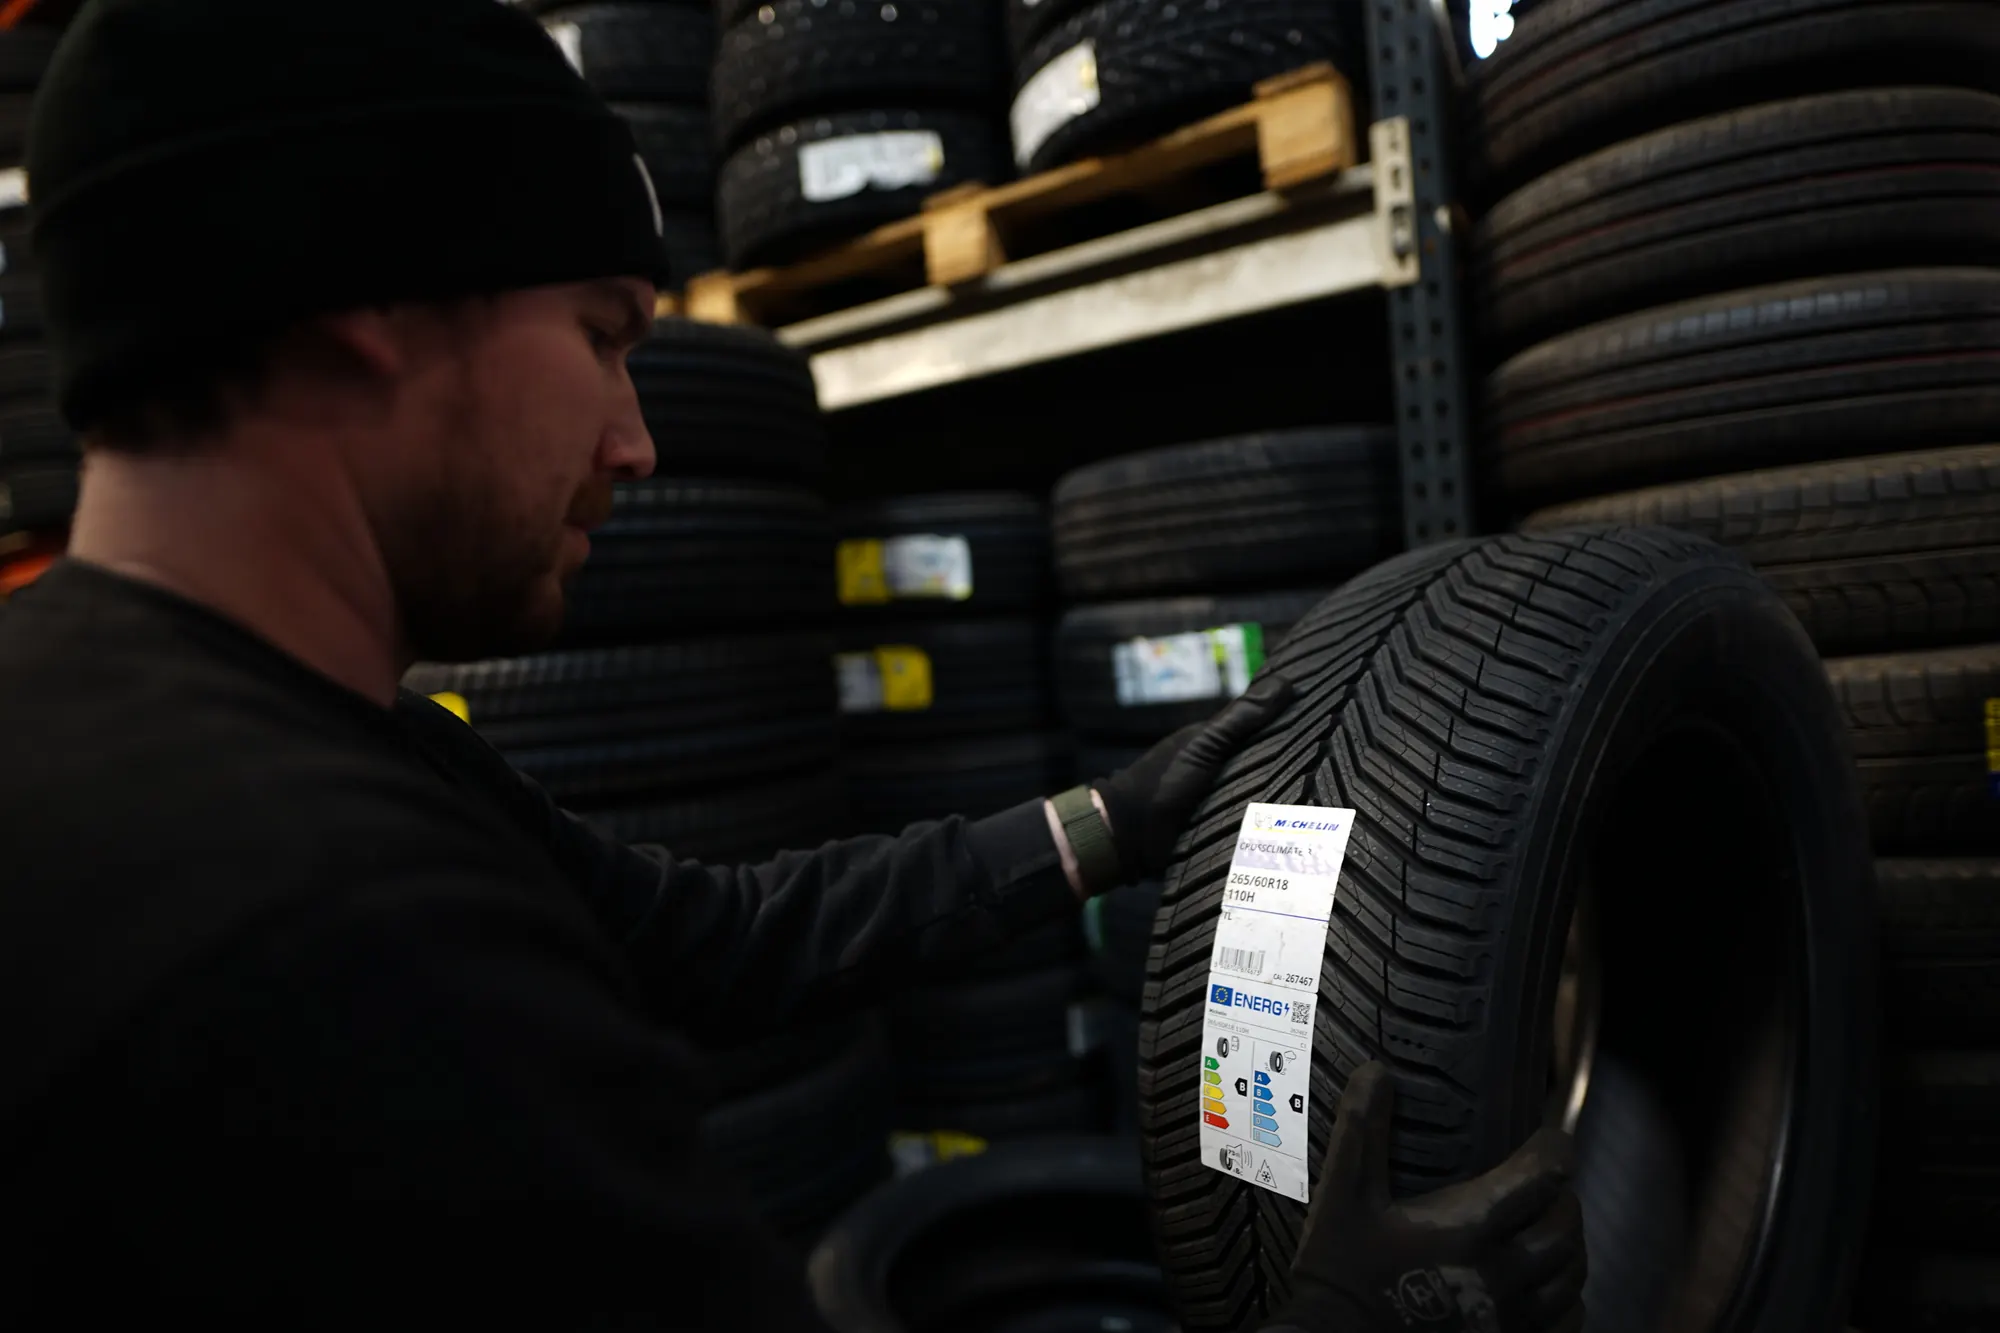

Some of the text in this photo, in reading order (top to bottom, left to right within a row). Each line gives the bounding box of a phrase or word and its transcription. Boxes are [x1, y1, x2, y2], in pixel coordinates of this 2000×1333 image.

[1274, 819, 1339, 832] MICHELIN
[1230, 873, 1289, 891] 265/60R18
[1228, 889, 1256, 903] 110H
[1223, 911, 1232, 921] TL
[1285, 973, 1314, 987] 267467
[1234, 991, 1283, 1016] ENERG
[1256, 1074, 1263, 1082] A
[1240, 1082, 1246, 1092] B
[1256, 1089, 1262, 1097] B
[1294, 1098, 1301, 1108] B
